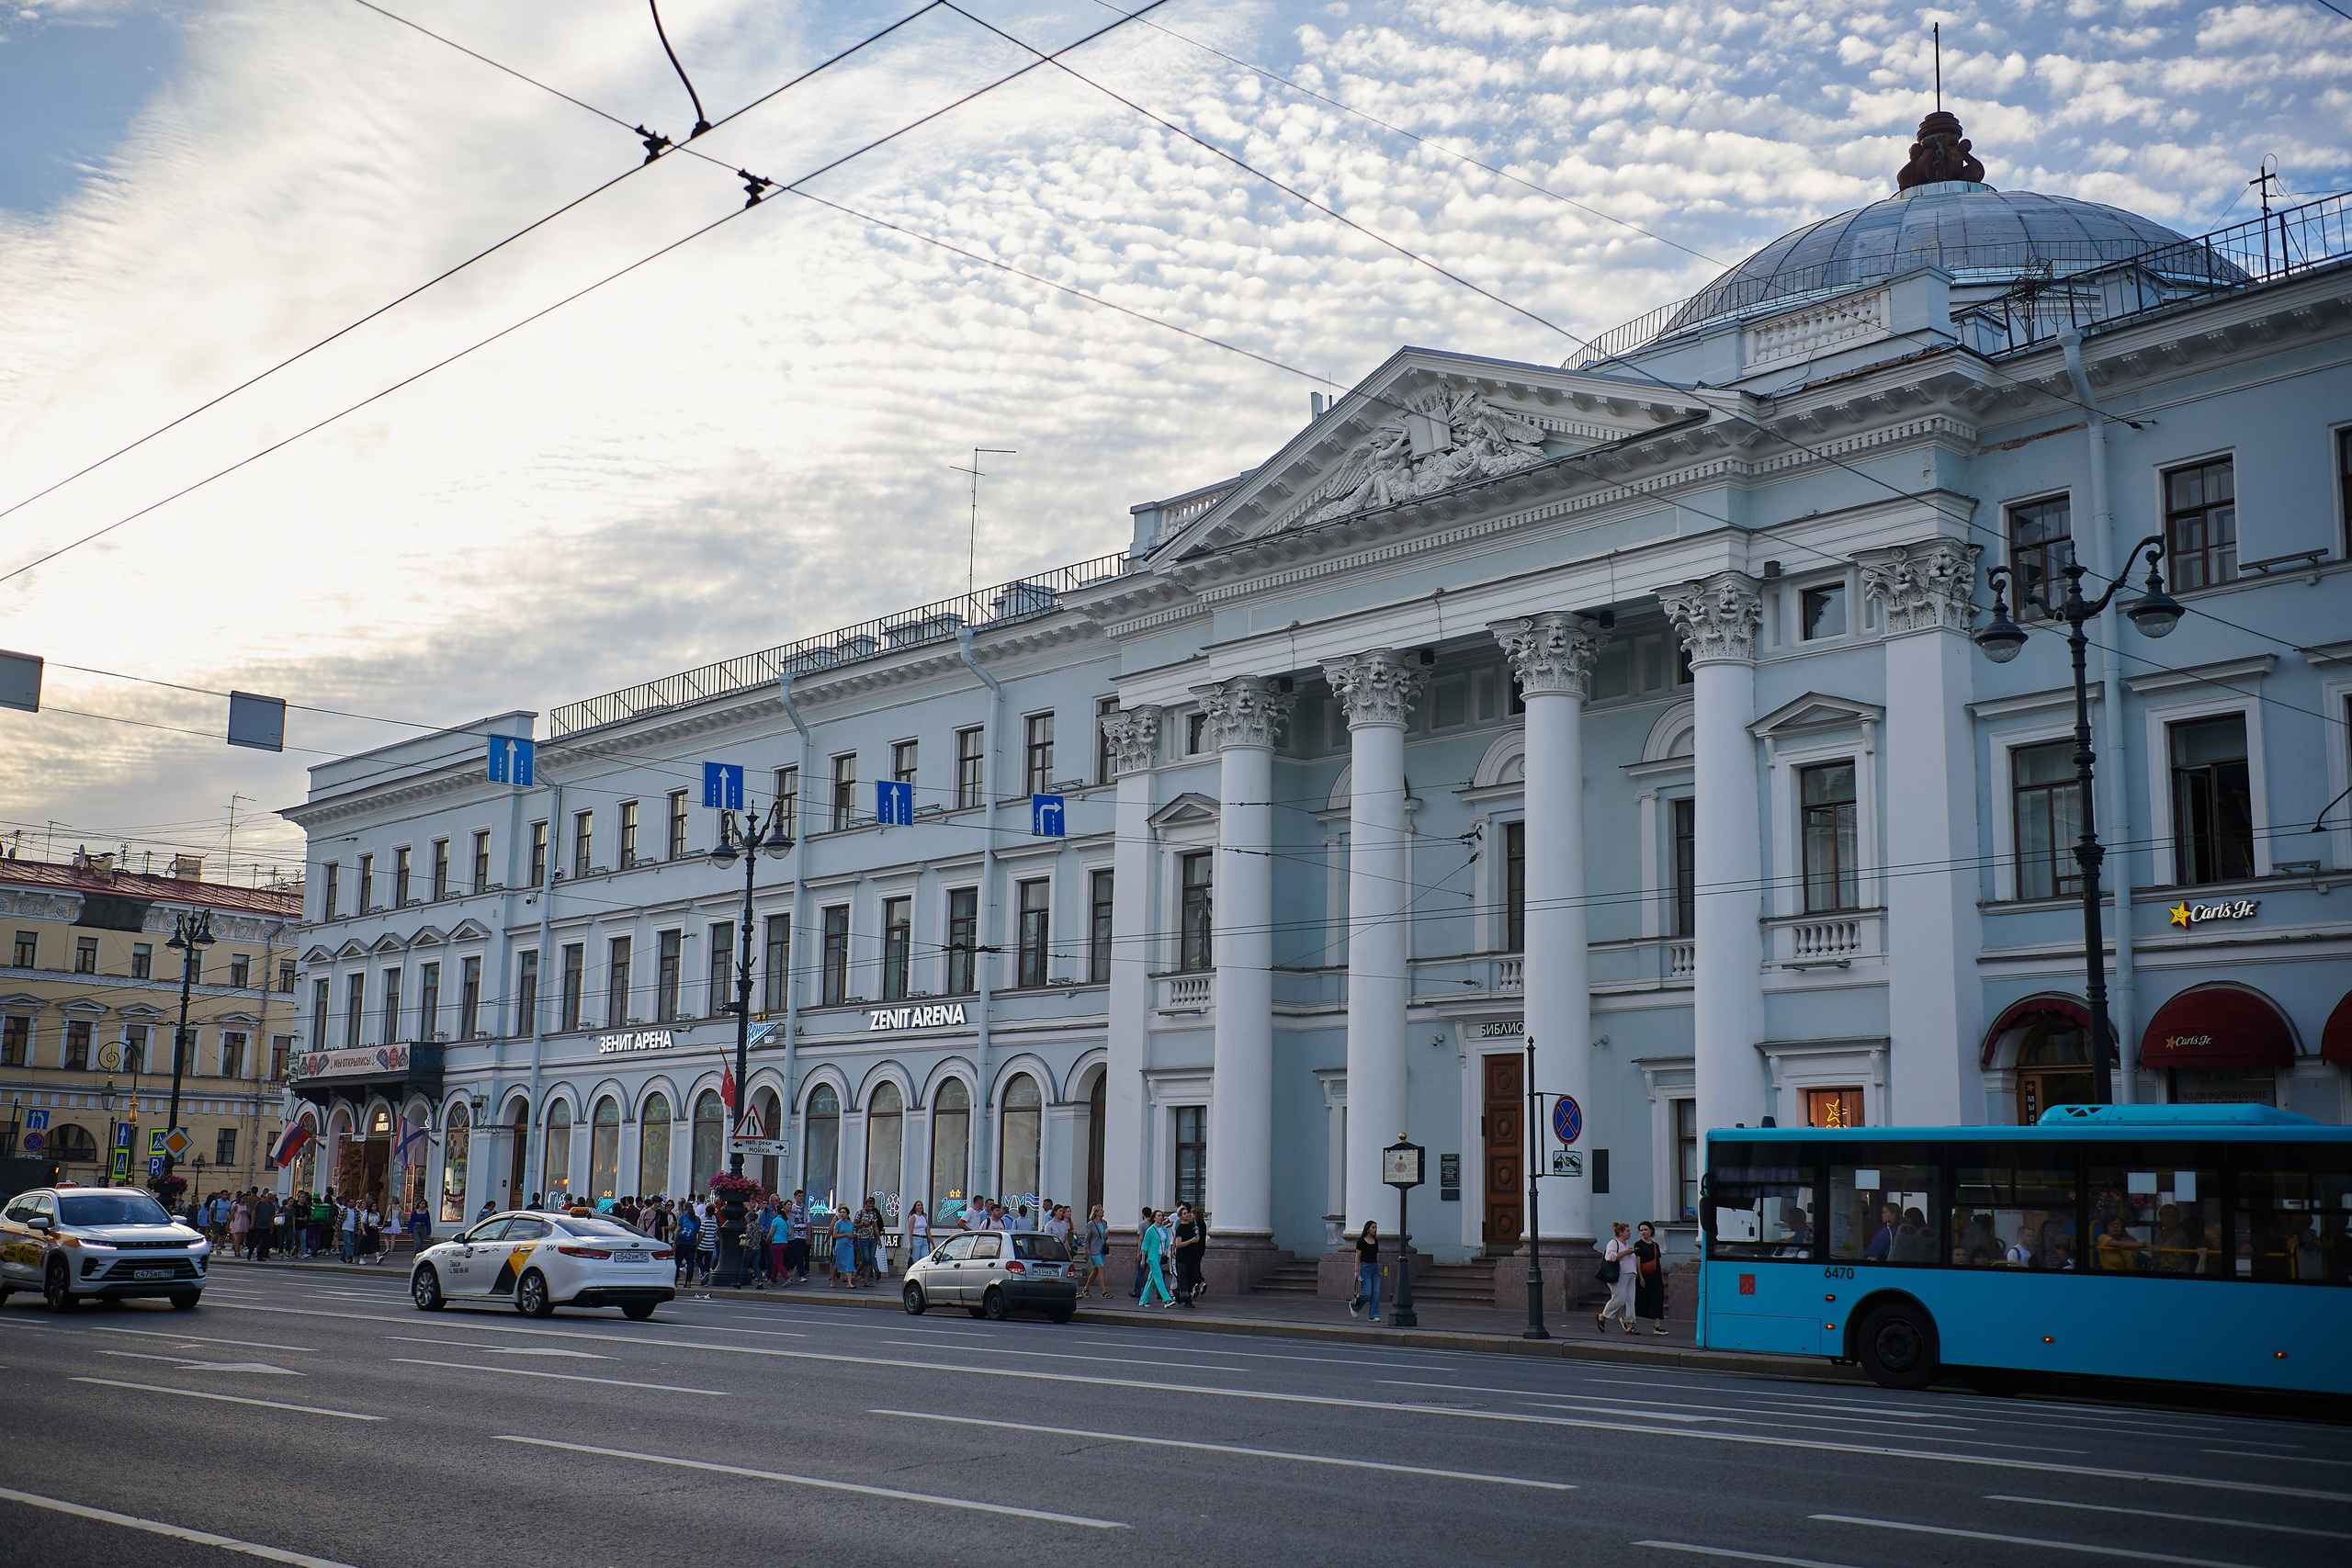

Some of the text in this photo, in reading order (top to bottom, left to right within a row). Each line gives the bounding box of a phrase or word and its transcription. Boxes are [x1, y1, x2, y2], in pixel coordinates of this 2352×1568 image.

[2190, 900, 2255, 922] Carl's Jr.
[870, 1004, 966, 1030] ZENIT ARENA
[599, 1031, 673, 1054] ЗЕНИТ АРЕНА
[2176, 1035, 2212, 1046] Carl's Jr.
[334, 1059, 343, 1067] МЫ
[2183, 1089, 2269, 1100] КАЛИФОРНИЙСКИЕ
[1825, 1267, 1854, 1279] 6470
